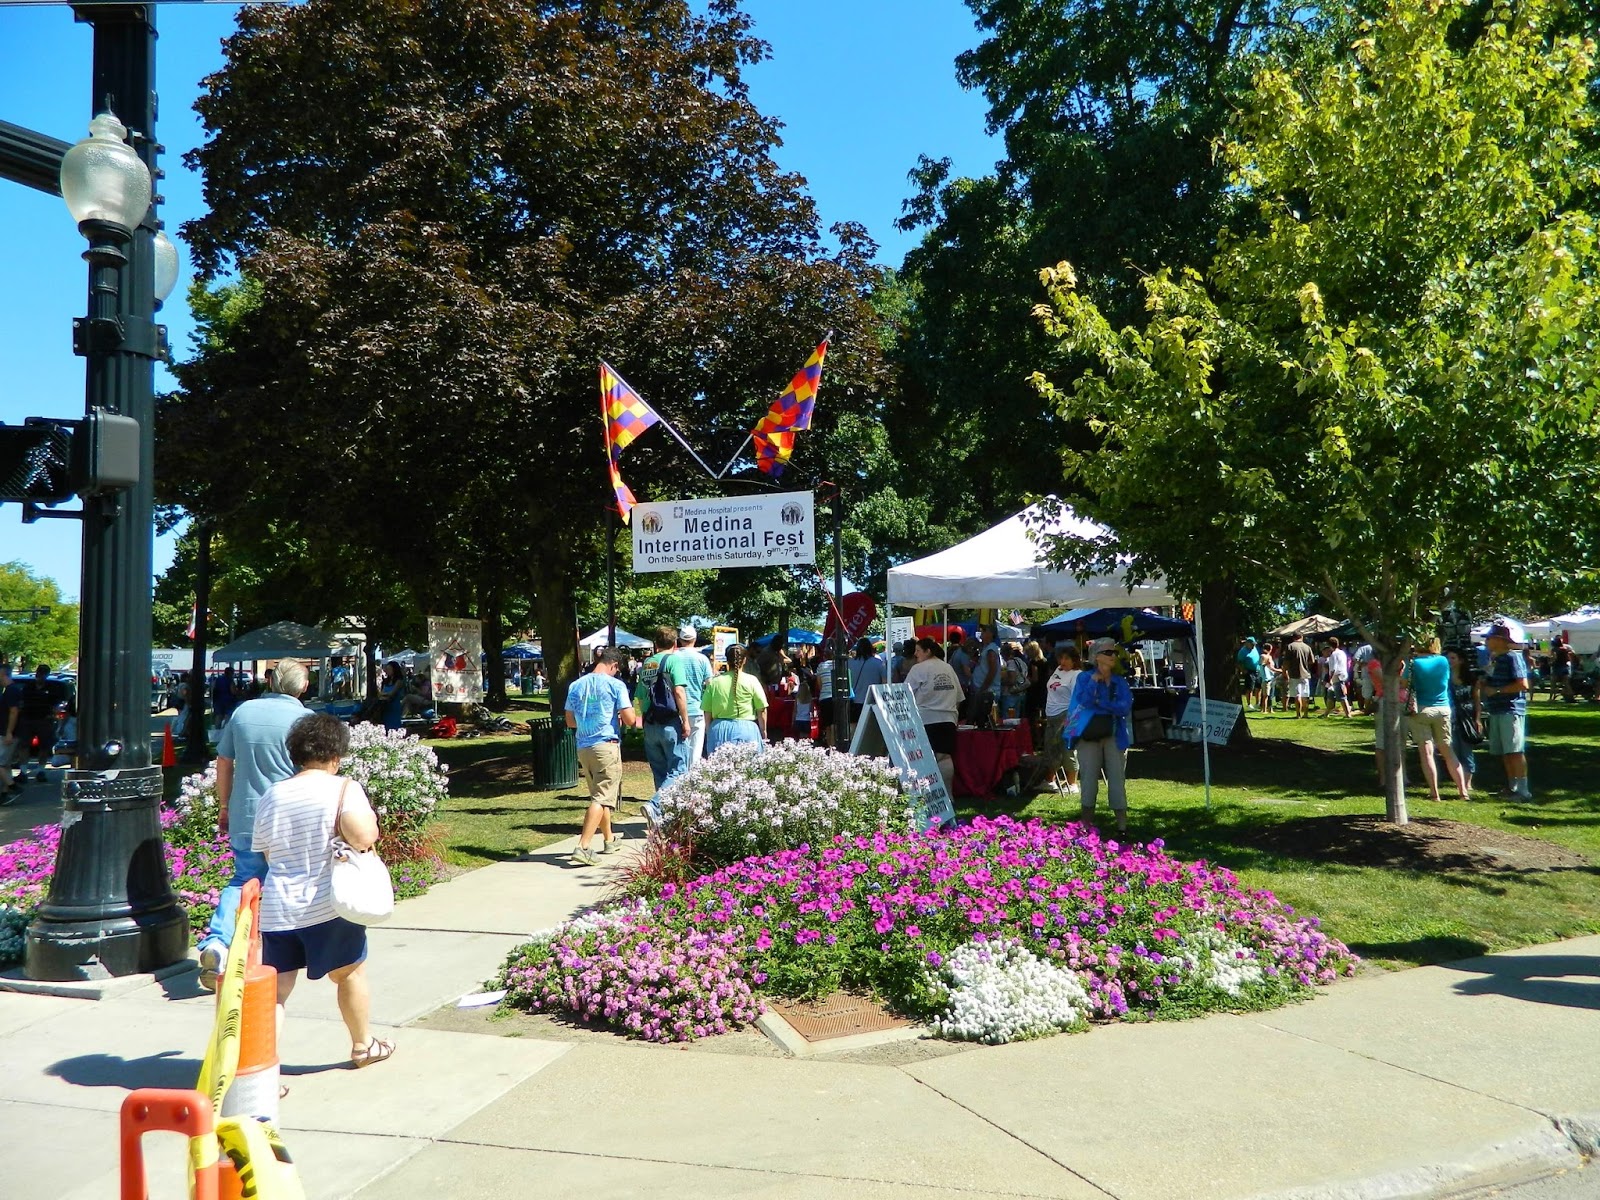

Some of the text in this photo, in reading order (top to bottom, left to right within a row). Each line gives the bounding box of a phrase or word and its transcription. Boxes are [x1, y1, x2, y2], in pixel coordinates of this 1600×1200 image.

[684, 504, 763, 516] Medina Hospital presents
[684, 516, 752, 533] Medina
[639, 530, 804, 554] International Fest
[648, 556, 660, 564] On
[661, 555, 674, 563] the
[676, 554, 705, 564] Square
[707, 552, 722, 561] this
[724, 550, 765, 560] Saturday,
